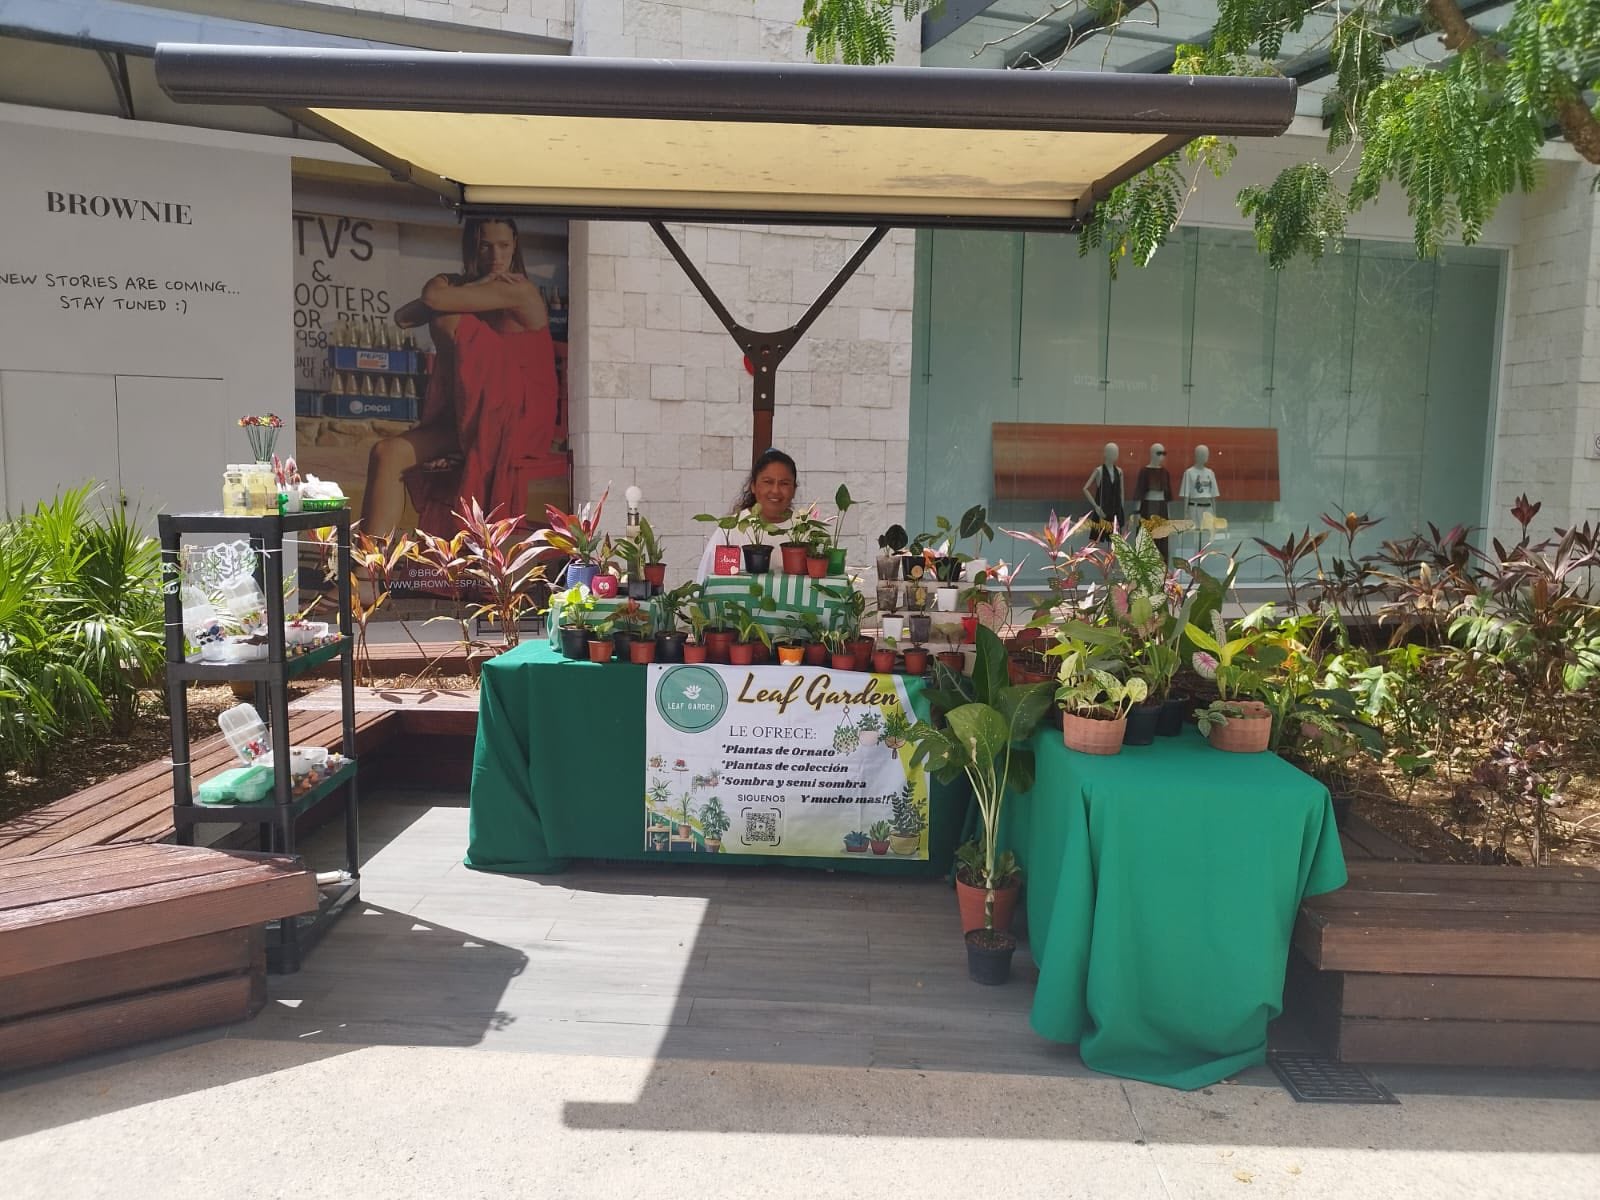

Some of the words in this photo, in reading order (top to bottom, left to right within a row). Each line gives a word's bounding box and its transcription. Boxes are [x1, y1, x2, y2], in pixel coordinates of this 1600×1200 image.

[47, 191, 192, 225] BROWNIE
[293, 215, 373, 261] TV'S
[311, 260, 332, 282] &
[0, 273, 37, 285] NEW
[45, 273, 118, 289] STORIES
[125, 277, 158, 291] ARE
[165, 280, 240, 295] COMING...
[60, 295, 105, 310] STAY
[113, 298, 166, 312] TUNED
[175, 300, 187, 314] :)
[294, 283, 391, 314] OOTERS
[293, 309, 322, 329] OR
[363, 402, 391, 413] pepsi
[737, 671, 804, 714] Leaf
[805, 674, 899, 711] Garden
[667, 702, 684, 711] LEAF
[688, 703, 716, 711] GARDEN
[729, 725, 748, 737] LE
[752, 726, 817, 740] OFRECE:
[775, 745, 790, 756] de
[791, 747, 835, 757] Ornato
[775, 761, 790, 771] de
[791, 761, 849, 773] colección
[775, 779, 785, 789] y
[786, 778, 817, 788] semi
[818, 780, 867, 789] sombra
[737, 794, 786, 803] SIGUENOS
[800, 795, 811, 803] Y
[809, 795, 855, 804] mucho
